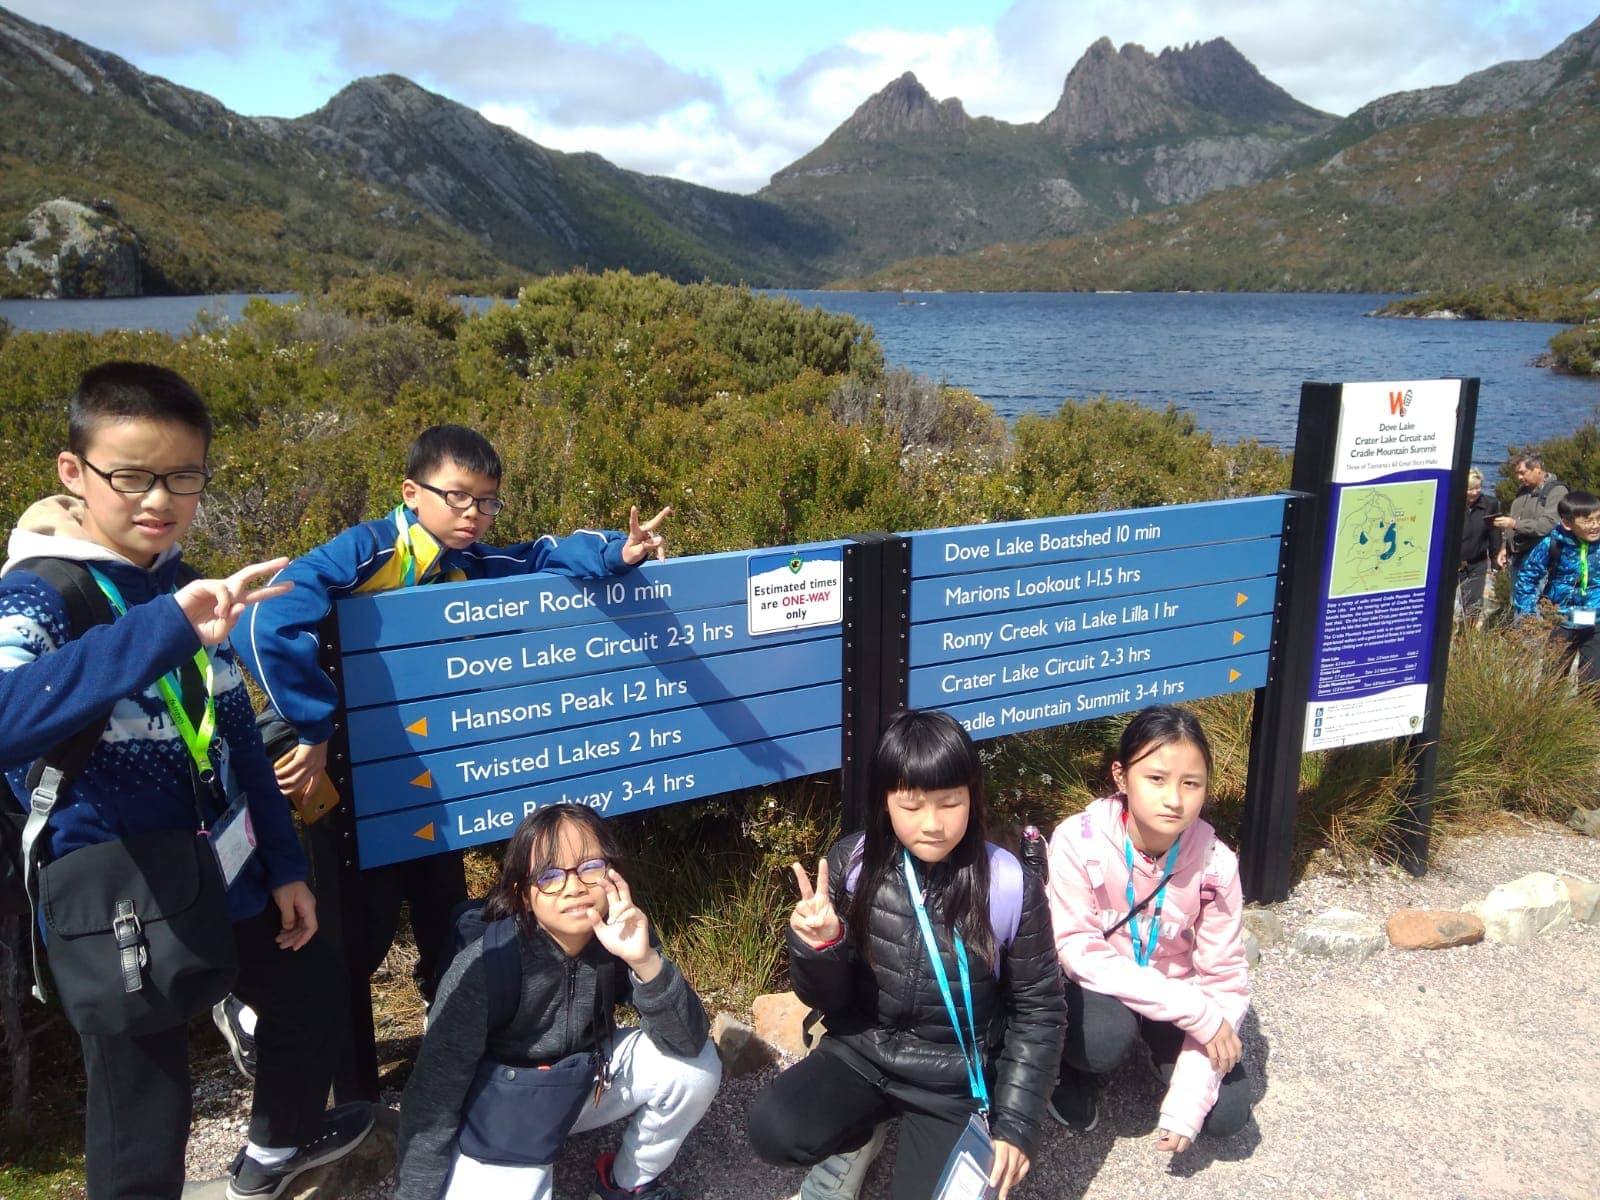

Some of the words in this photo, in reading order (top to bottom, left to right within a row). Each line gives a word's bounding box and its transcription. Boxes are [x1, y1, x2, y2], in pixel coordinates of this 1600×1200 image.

[1355, 436, 1379, 446] Crater
[1380, 435, 1397, 444] Lake
[1399, 433, 1421, 443] Circuit
[1422, 432, 1436, 441] and
[1379, 423, 1397, 432] Dove
[1399, 422, 1415, 431] Lake
[1350, 449, 1375, 458] Cradle
[1376, 446, 1409, 457] Mountain
[1410, 444, 1437, 454] Summit
[945, 543, 990, 562] Dove
[995, 536, 1034, 557] Lake
[1039, 526, 1112, 552] Boatshed
[1116, 524, 1130, 543] 10
[1135, 523, 1161, 541] min
[444, 598, 530, 624] Glacier
[539, 587, 596, 613] Rock
[607, 583, 625, 605] 10
[635, 579, 672, 601] min
[754, 579, 806, 597] Estimated
[809, 578, 837, 590] times
[760, 600, 778, 611] are
[782, 590, 831, 607] ONE-WAY
[945, 585, 1010, 606] Marions
[1016, 575, 1081, 597] Lookout
[1086, 568, 1113, 587] 1-1.5
[1117, 567, 1141, 584] hrs
[785, 608, 807, 620] only
[943, 631, 994, 651] Ronny
[999, 619, 1049, 642] Creek
[1054, 616, 1077, 633] via
[1082, 610, 1117, 630] Lake
[1122, 605, 1149, 624] Lilla
[1153, 602, 1160, 619] 1
[1163, 601, 1179, 618] hr
[446, 656, 513, 679] Dove
[522, 643, 577, 668] Lake
[585, 632, 658, 658] Circuit
[667, 624, 695, 647] 2-3
[702, 622, 734, 642] hrs
[941, 673, 997, 693] Crater
[1002, 663, 1039, 684] Lake
[1044, 655, 1096, 676] Circuit
[1100, 648, 1124, 668] 2-3
[1128, 646, 1151, 663] hrs
[451, 702, 552, 732] Hansons
[561, 687, 614, 714] Peak
[623, 680, 648, 703] 1-2
[655, 678, 687, 698] hrs
[959, 711, 996, 732] adle
[1001, 699, 1072, 725] Mountain
[1076, 688, 1131, 712] Summit
[1135, 681, 1159, 701] 3-4
[1162, 679, 1185, 696] hrs
[456, 752, 549, 783] Twisted
[558, 740, 620, 765] Lakes
[629, 731, 642, 752] 2
[650, 728, 682, 748] hrs
[458, 809, 514, 836] Lake
[523, 790, 613, 818] Rway
[622, 776, 656, 801] 3-4
[663, 773, 695, 793] hrs
